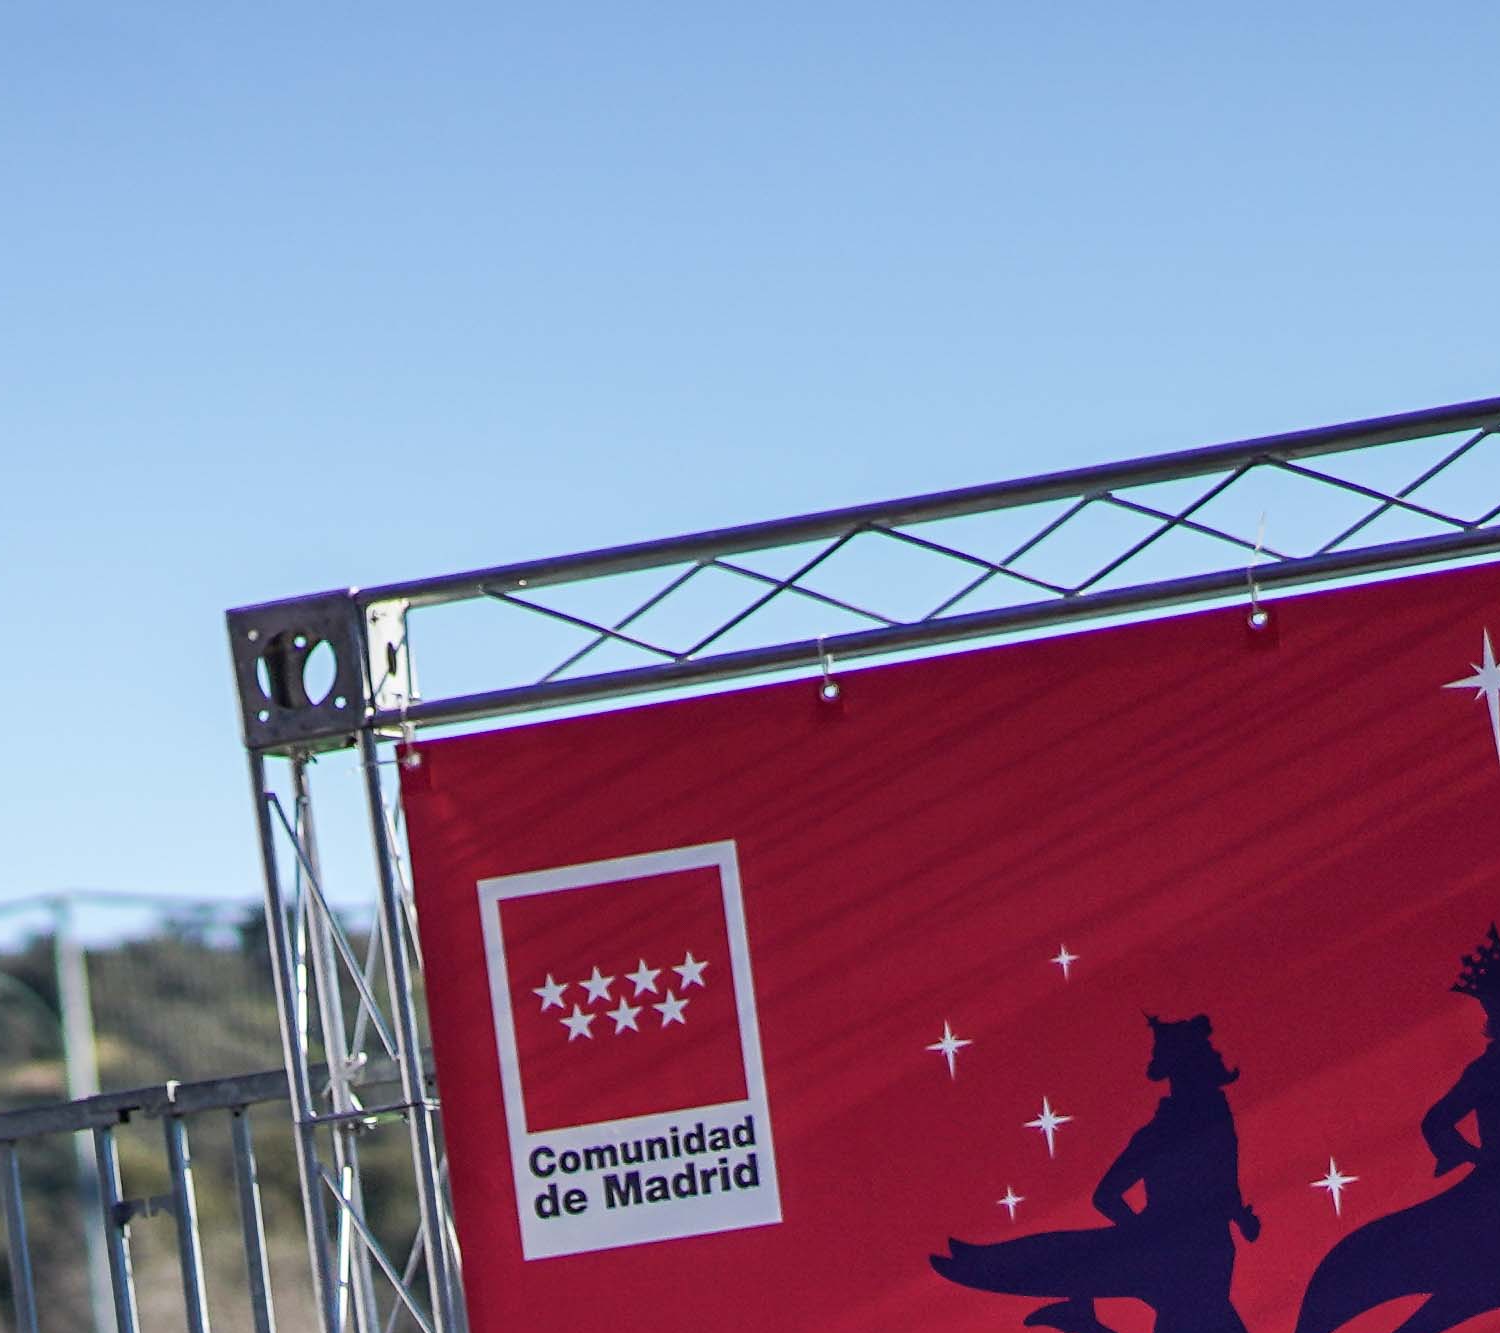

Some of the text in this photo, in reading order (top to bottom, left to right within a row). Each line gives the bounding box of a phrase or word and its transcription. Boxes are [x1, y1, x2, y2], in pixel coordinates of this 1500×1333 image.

[529, 1114, 756, 1178] Comunidad
[534, 1153, 760, 1219] de Madrid
